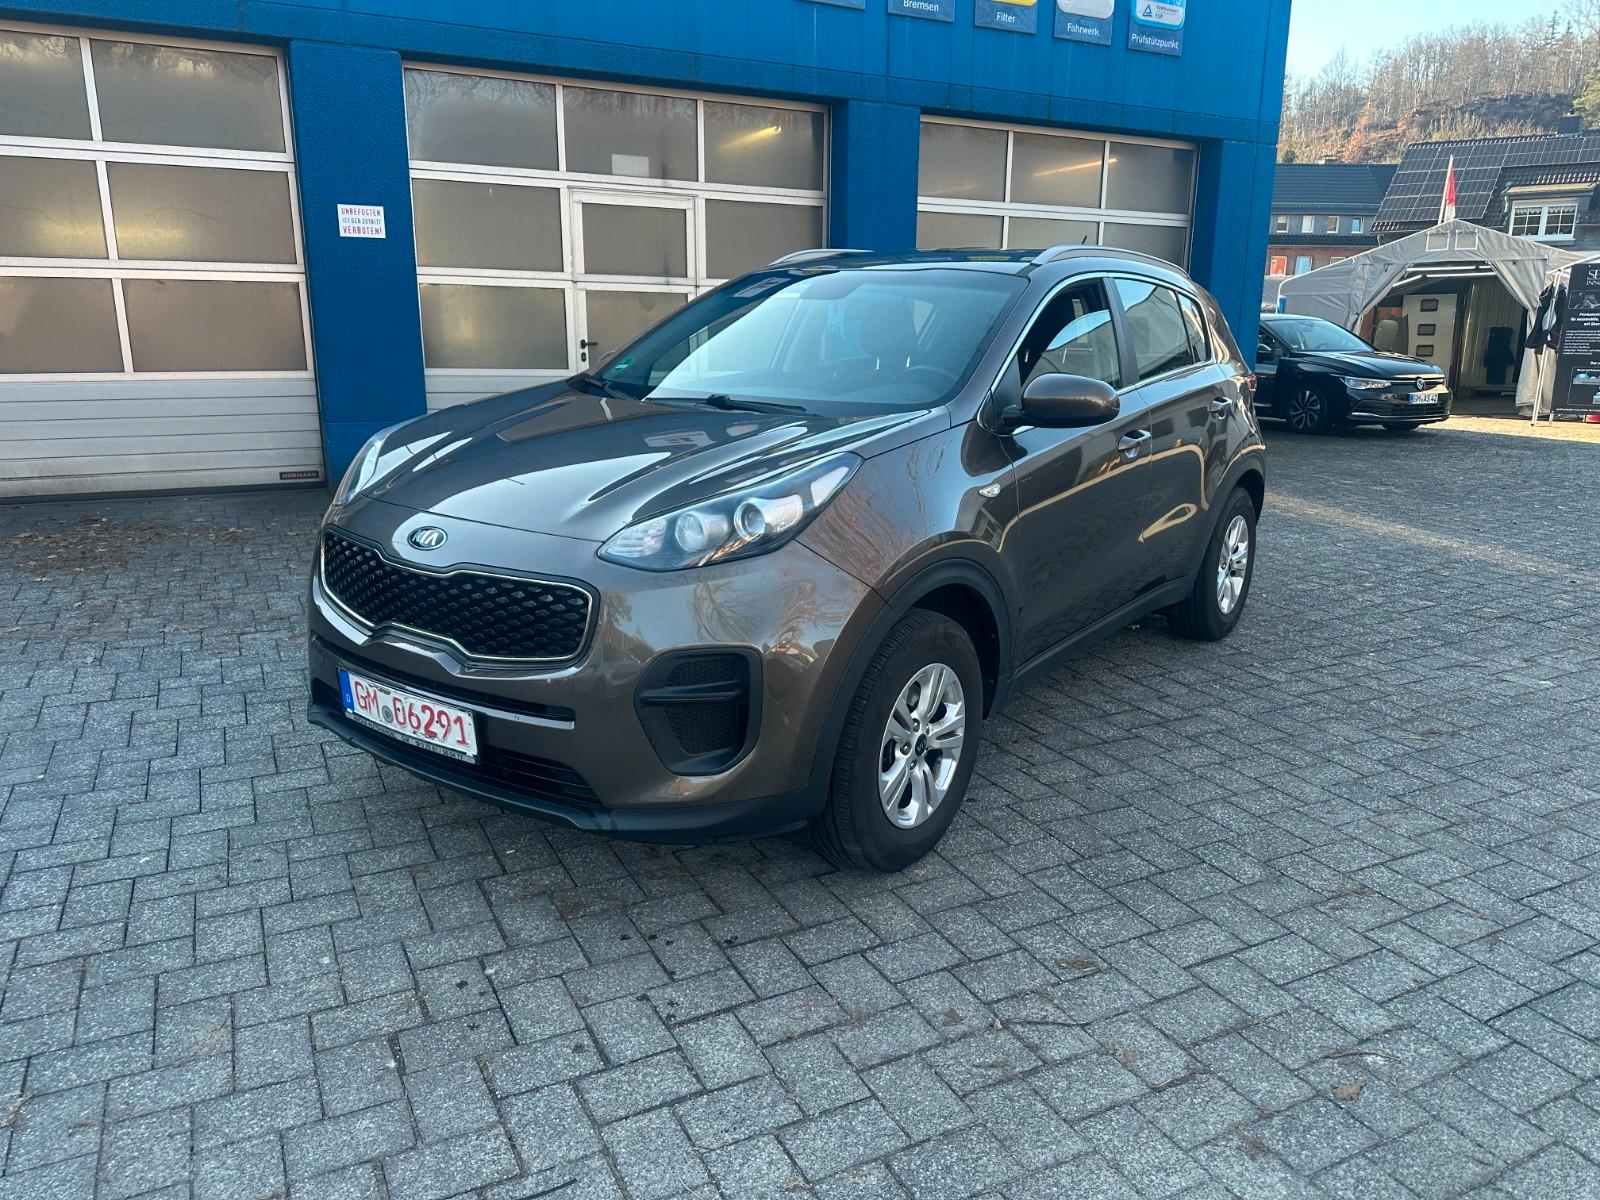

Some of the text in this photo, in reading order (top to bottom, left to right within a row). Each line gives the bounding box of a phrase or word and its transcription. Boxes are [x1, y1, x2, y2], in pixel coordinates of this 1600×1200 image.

[903, 0, 940, 13] Bremsen
[996, 11, 1016, 24] Filter
[1066, 22, 1100, 37] Fahrwerk
[1131, 33, 1179, 50] Prüfstützpunkt
[341, 207, 381, 217] UNBEFUGTEN
[342, 225, 382, 235] VERBOTEN!
[354, 680, 381, 720] GM
[392, 696, 470, 745] 06291
